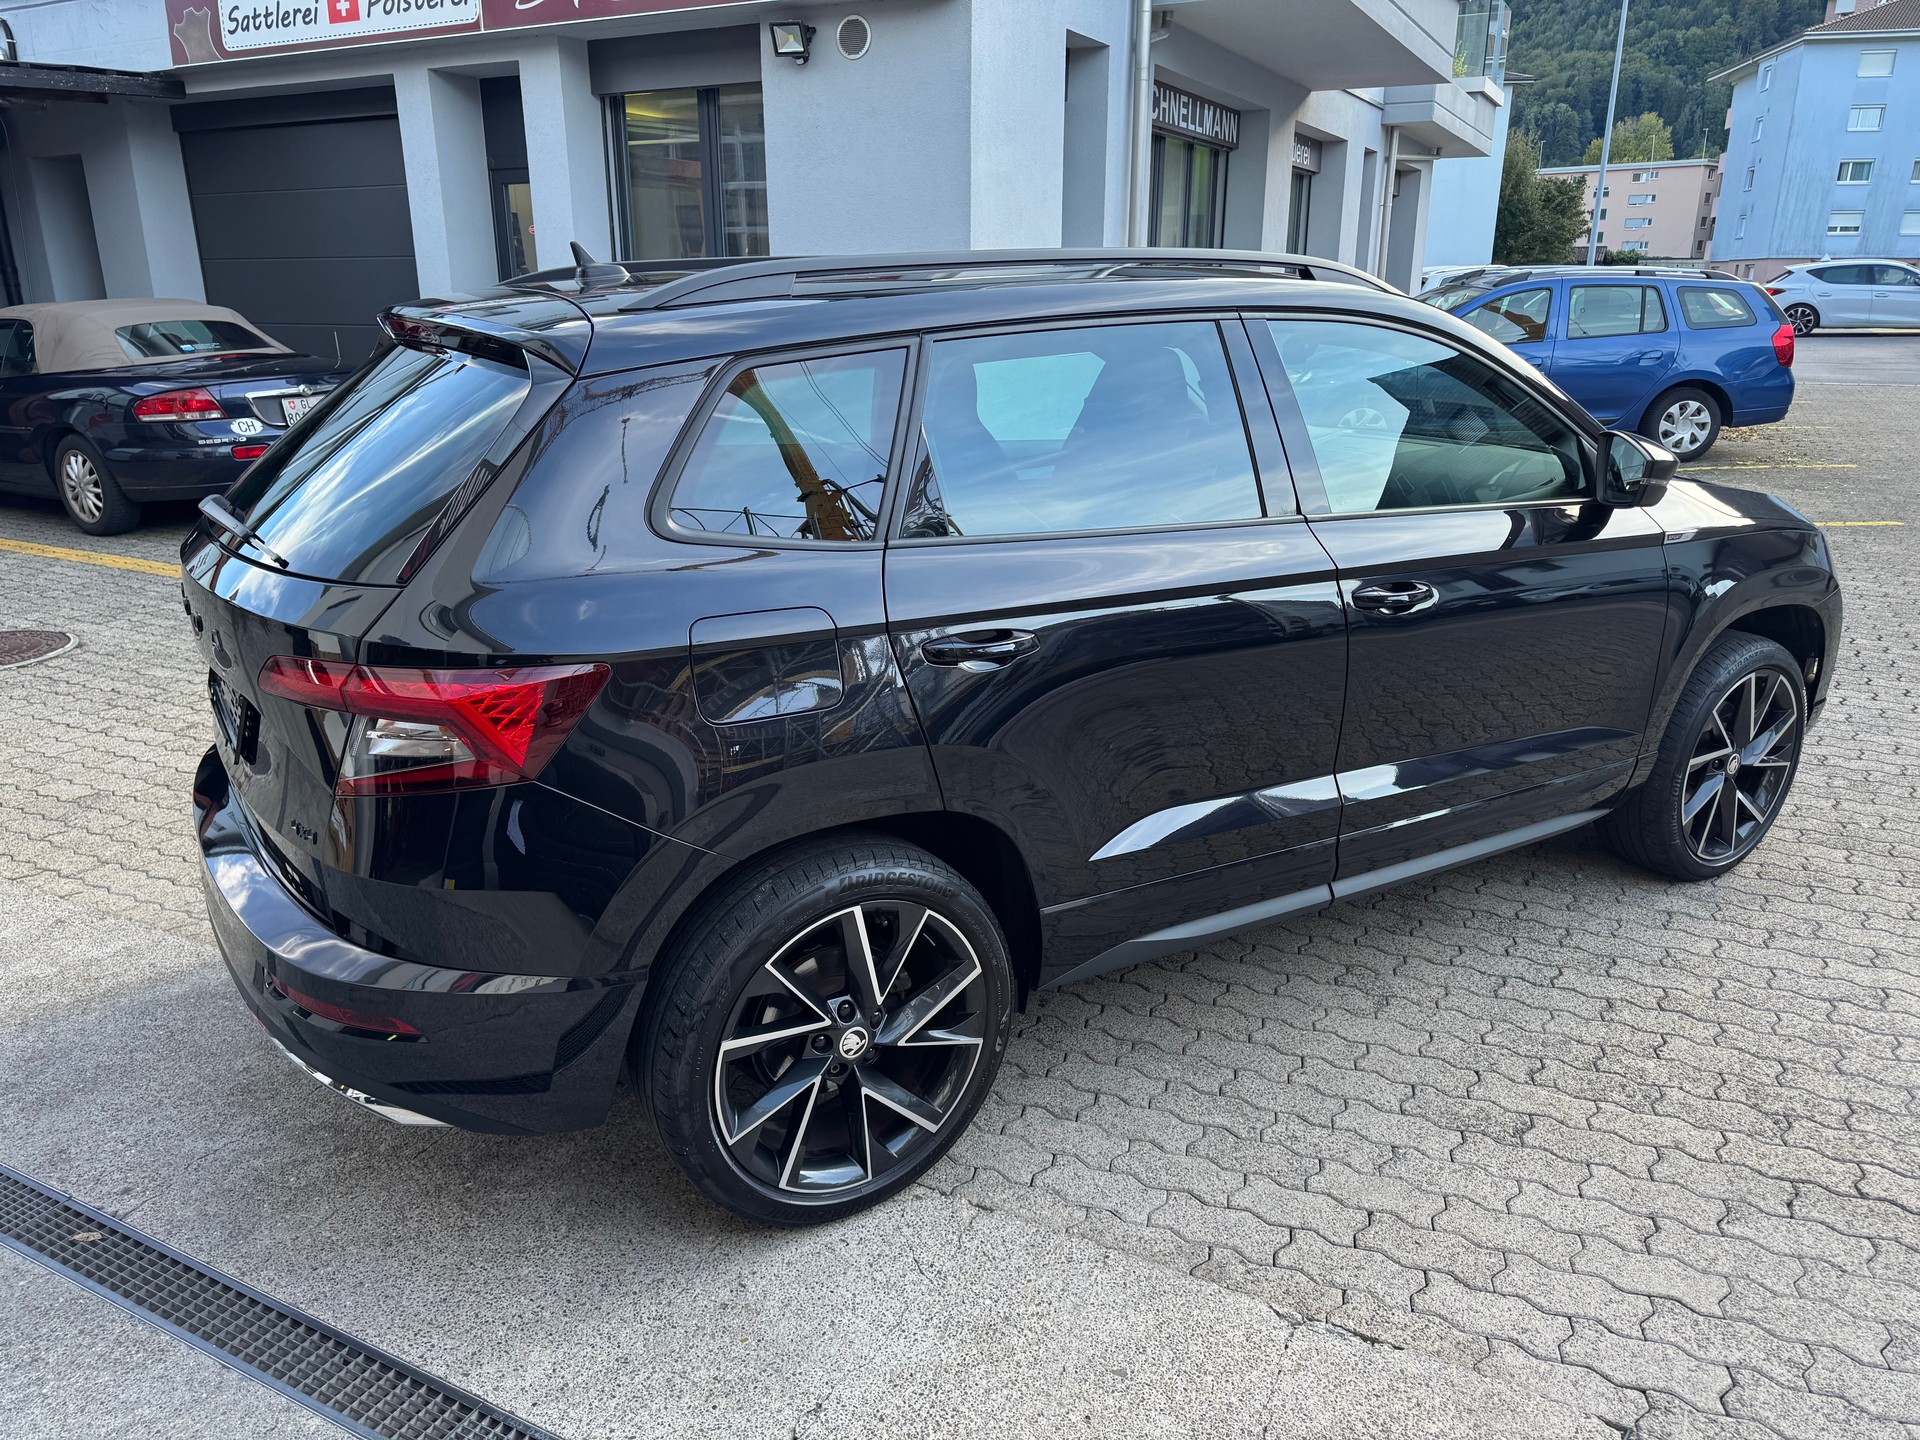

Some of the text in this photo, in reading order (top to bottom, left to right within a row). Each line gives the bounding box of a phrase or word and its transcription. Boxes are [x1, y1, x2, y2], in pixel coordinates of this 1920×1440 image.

[227, 0, 319, 35] Sattlerei
[300, 398, 311, 410] GL
[237, 421, 257, 433] CH
[1726, 650, 1765, 676] TURANZA
[839, 871, 954, 899] BRIDGESTONE
